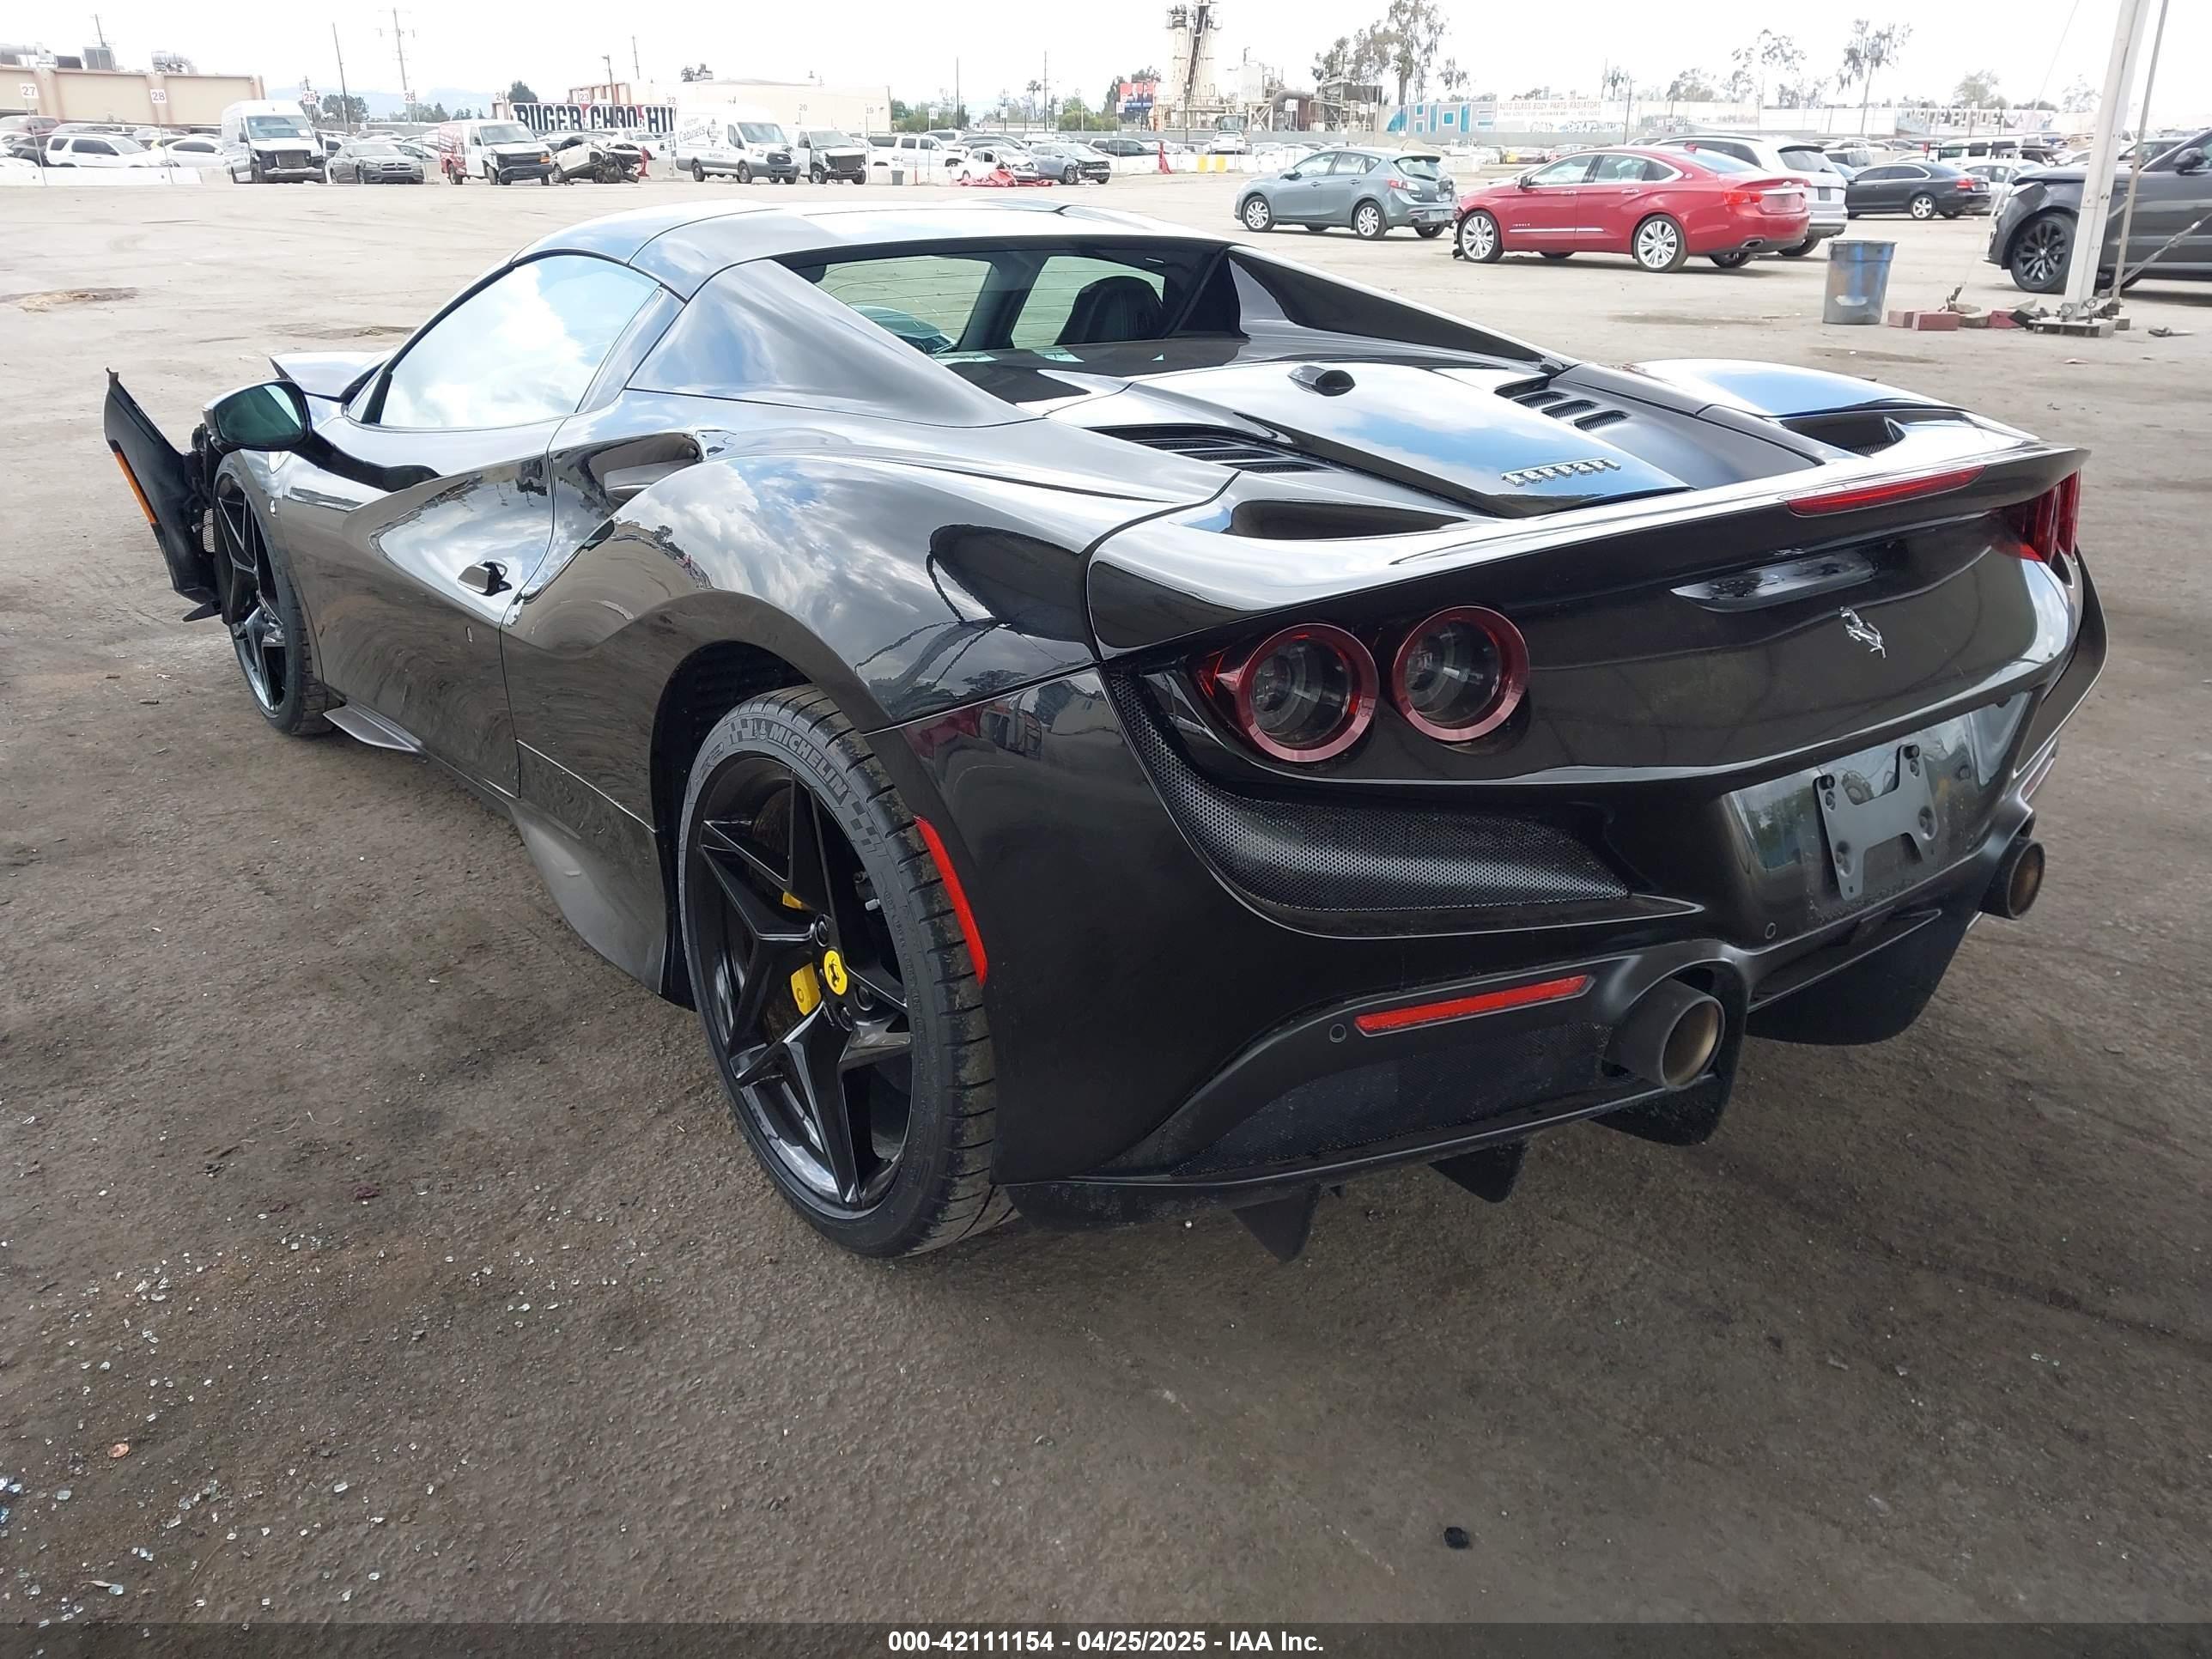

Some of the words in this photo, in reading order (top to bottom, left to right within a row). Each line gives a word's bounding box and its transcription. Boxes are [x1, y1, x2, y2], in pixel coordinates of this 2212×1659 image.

[21, 86, 36, 96] 27
[152, 91, 166, 101] 28
[580, 91, 591, 101] 23
[304, 94, 316, 102] 25
[667, 96, 677, 105] 22
[799, 103, 808, 112] 20
[678, 124, 706, 143] Cabinets
[1501, 456, 1622, 487] Ferrari
[769, 725, 849, 799] MICHELIN
